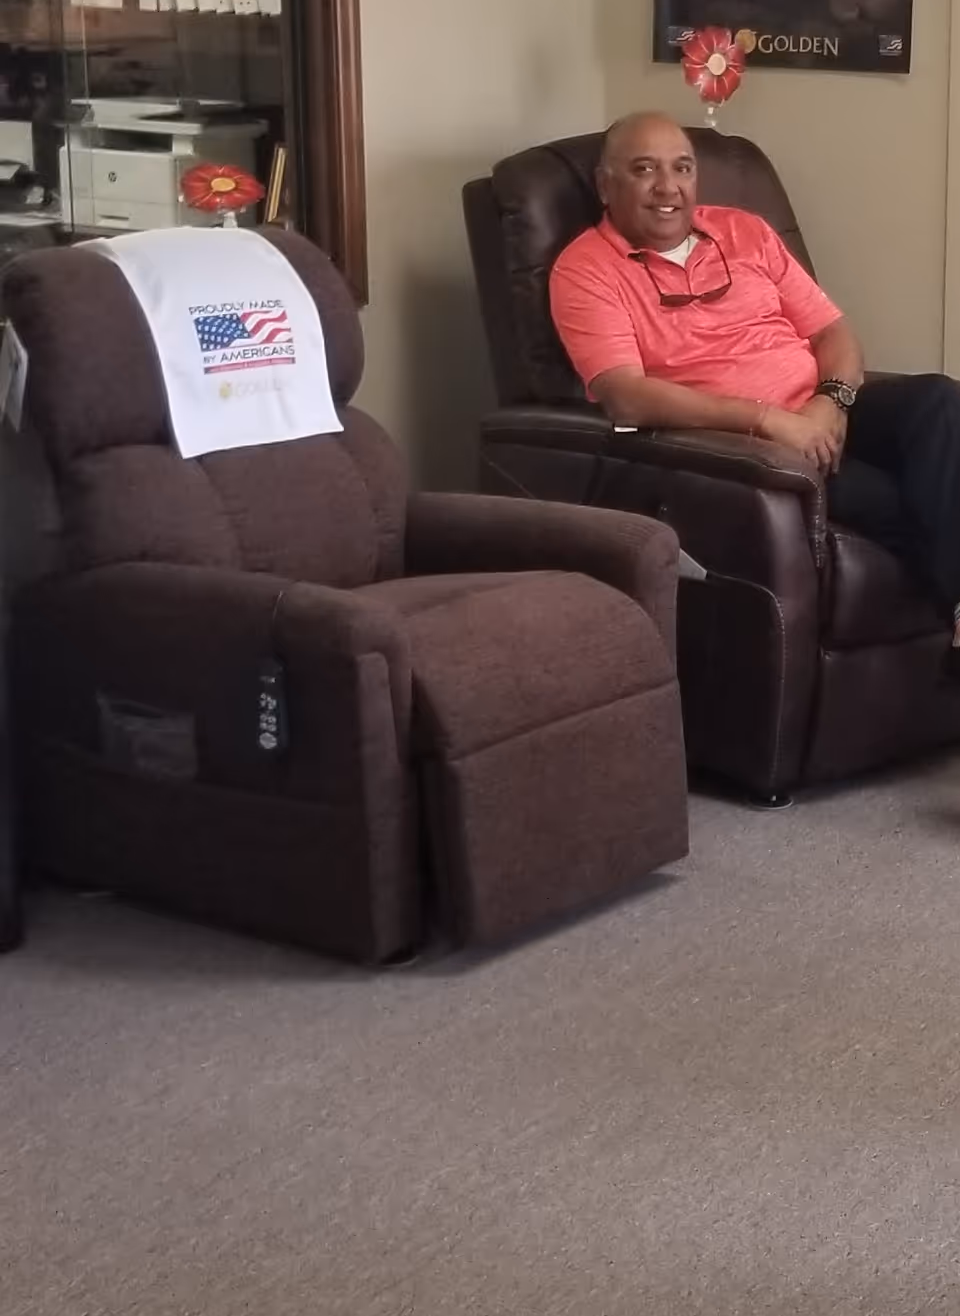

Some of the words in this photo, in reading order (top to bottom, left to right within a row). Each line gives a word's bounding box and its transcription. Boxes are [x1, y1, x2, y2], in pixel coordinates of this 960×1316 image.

[758, 34, 839, 57] GOLDEN
[188, 301, 244, 316] PROUDLY
[250, 299, 285, 309] MADE
[220, 345, 296, 363] AMERICANS
